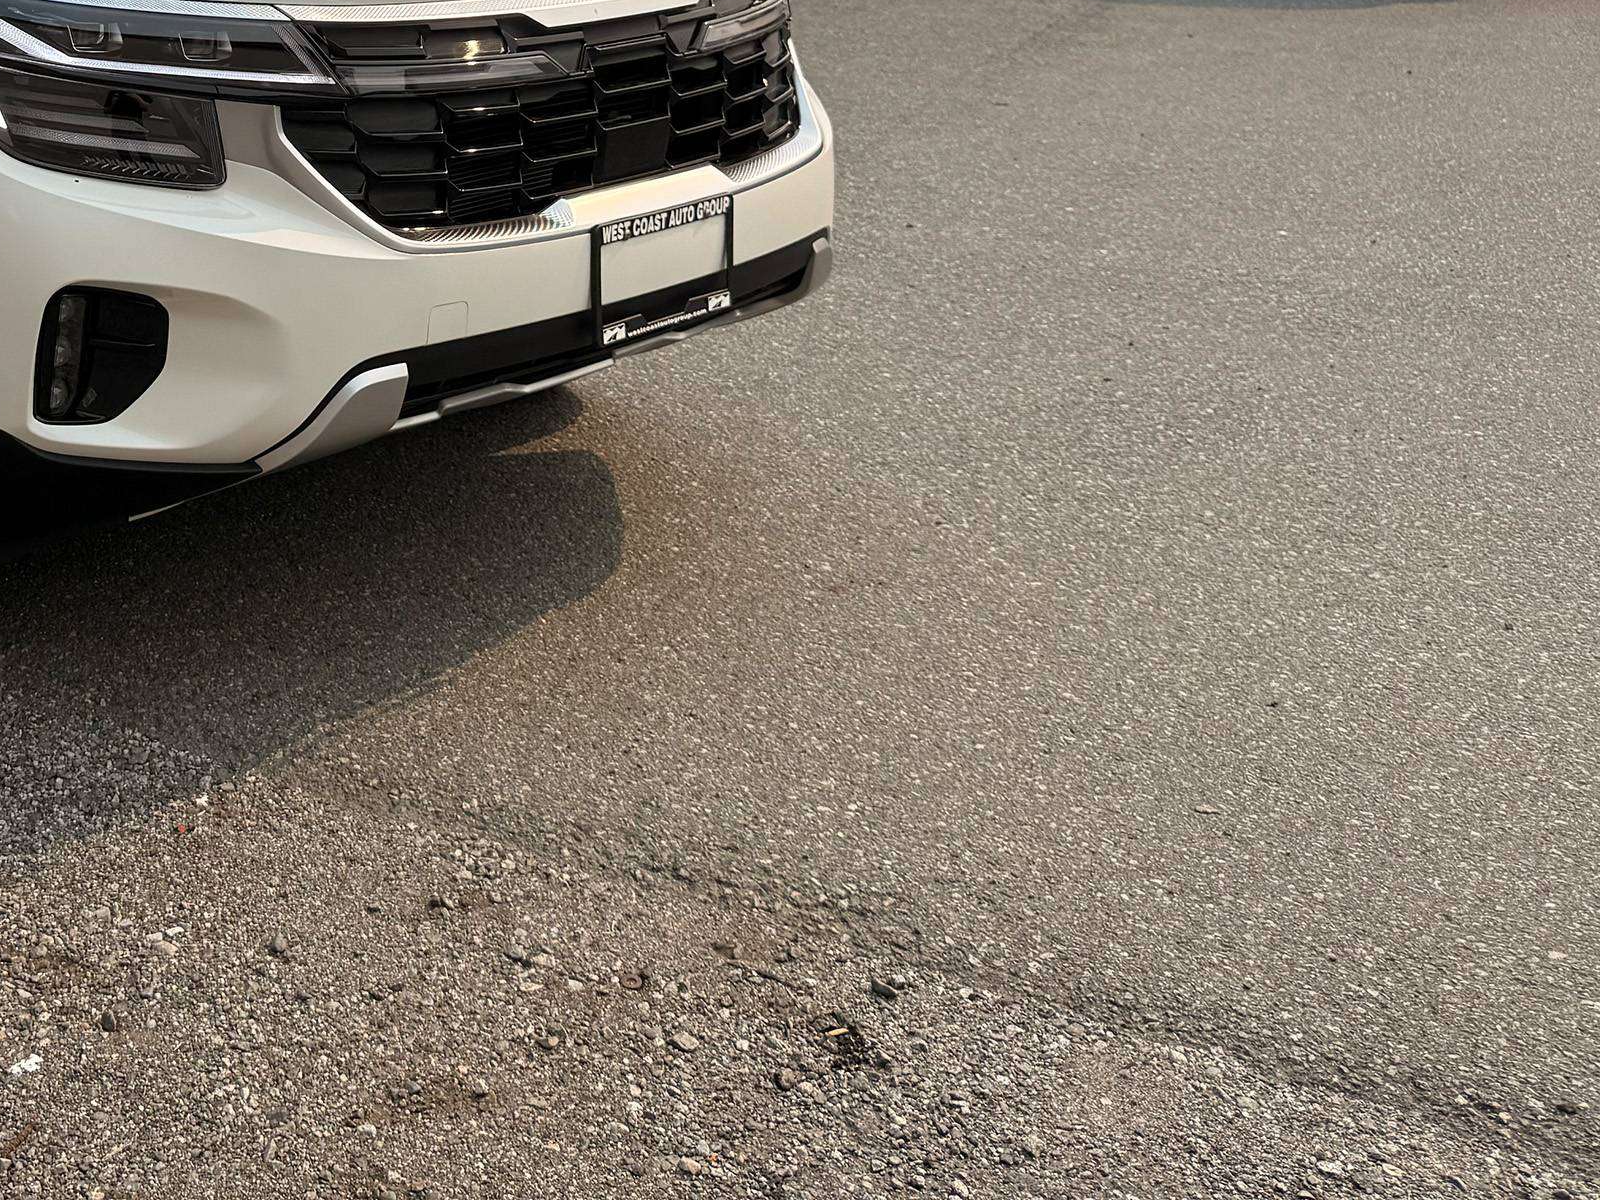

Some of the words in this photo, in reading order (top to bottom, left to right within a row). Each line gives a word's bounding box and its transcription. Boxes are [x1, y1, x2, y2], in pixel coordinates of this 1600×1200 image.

[602, 220, 631, 244] WEST
[633, 212, 668, 236] COAST
[668, 205, 695, 227] AUTO
[696, 196, 730, 220] GROUP
[627, 308, 707, 337] westcoastautogroup.com
